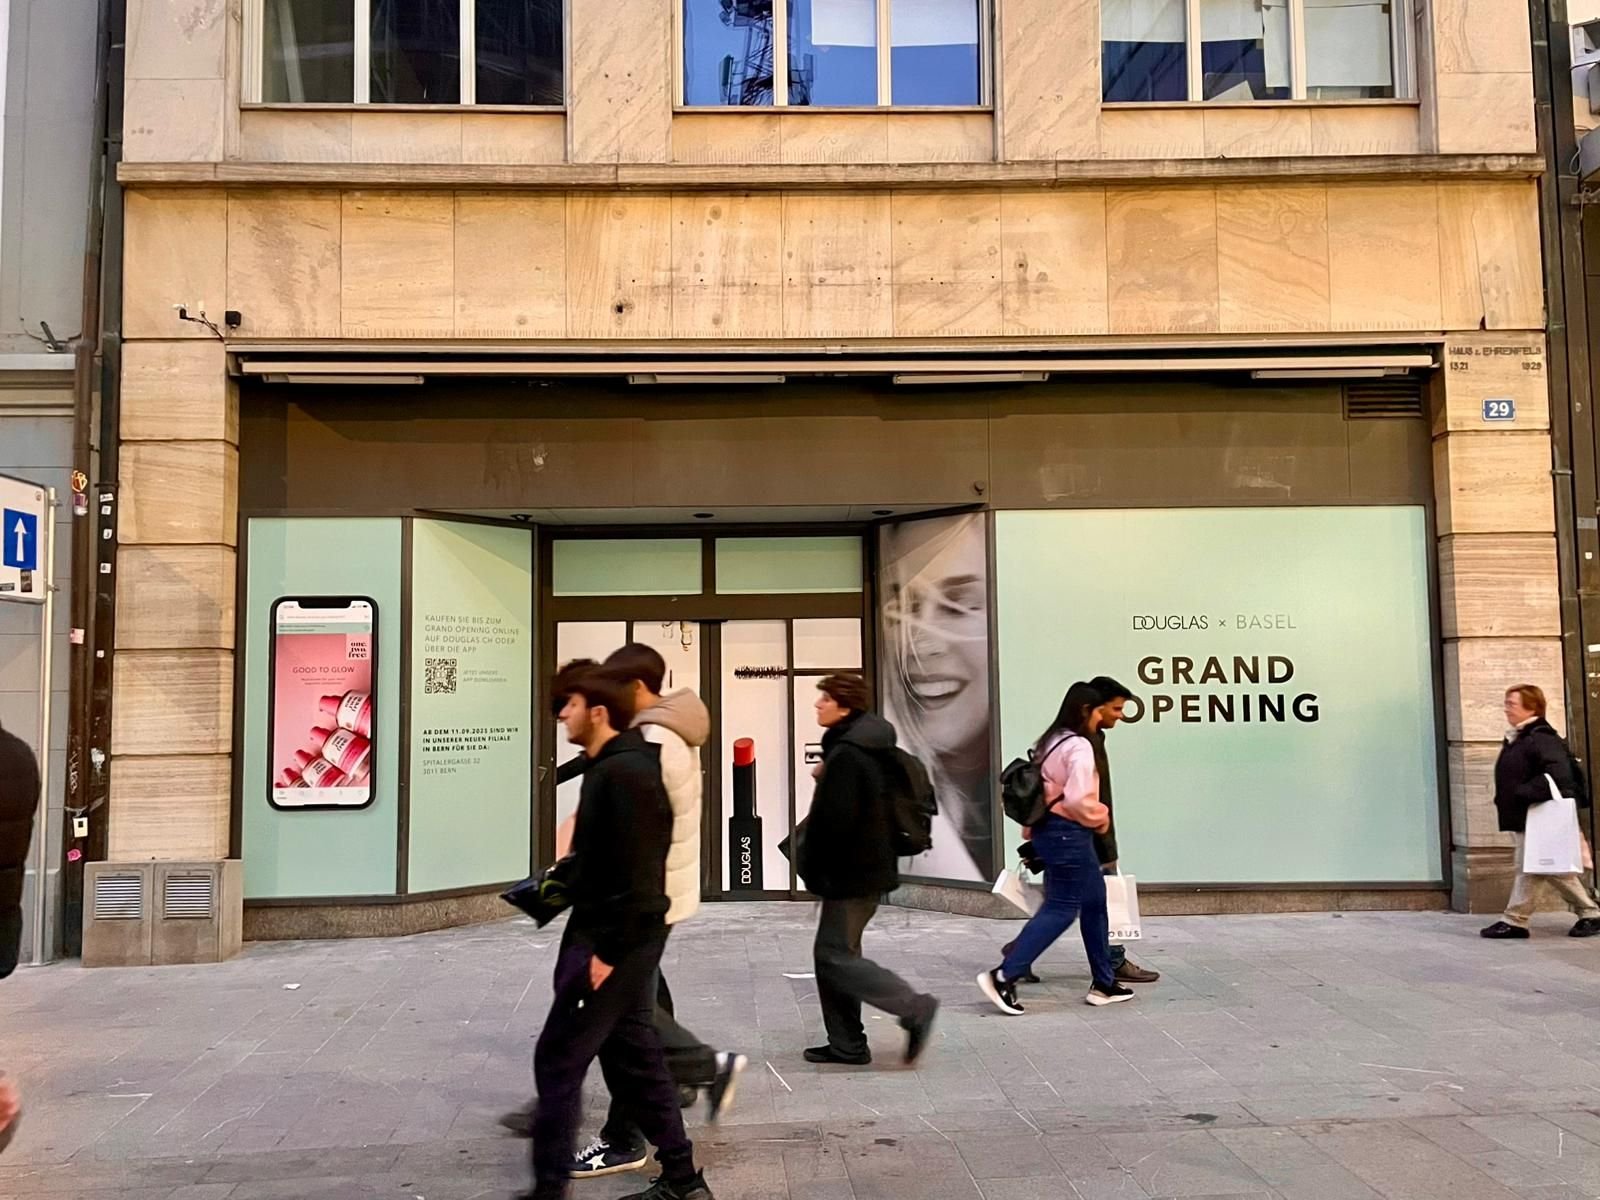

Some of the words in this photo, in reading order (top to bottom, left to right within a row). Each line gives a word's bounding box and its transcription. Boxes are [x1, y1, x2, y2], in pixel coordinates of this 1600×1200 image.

[1449, 346, 1473, 356] HAUS
[1489, 402, 1509, 417] 29
[425, 615, 456, 623] KAUFEN
[458, 616, 469, 624] SIE
[472, 616, 484, 624] BIS
[486, 617, 501, 625] ZUM
[1133, 615, 1208, 630] DOUGLAS
[1236, 614, 1297, 630] BASEL
[455, 626, 490, 634] OPENING
[492, 627, 520, 635] ONLINE
[495, 637, 515, 645] ODER
[425, 644, 445, 652] ÜBER
[448, 645, 459, 653] DIE
[292, 666, 317, 674] GOOD
[1137, 656, 1295, 685] GRAND
[1120, 693, 1320, 724] OPENING
[741, 836, 751, 884] DOUGLAS
